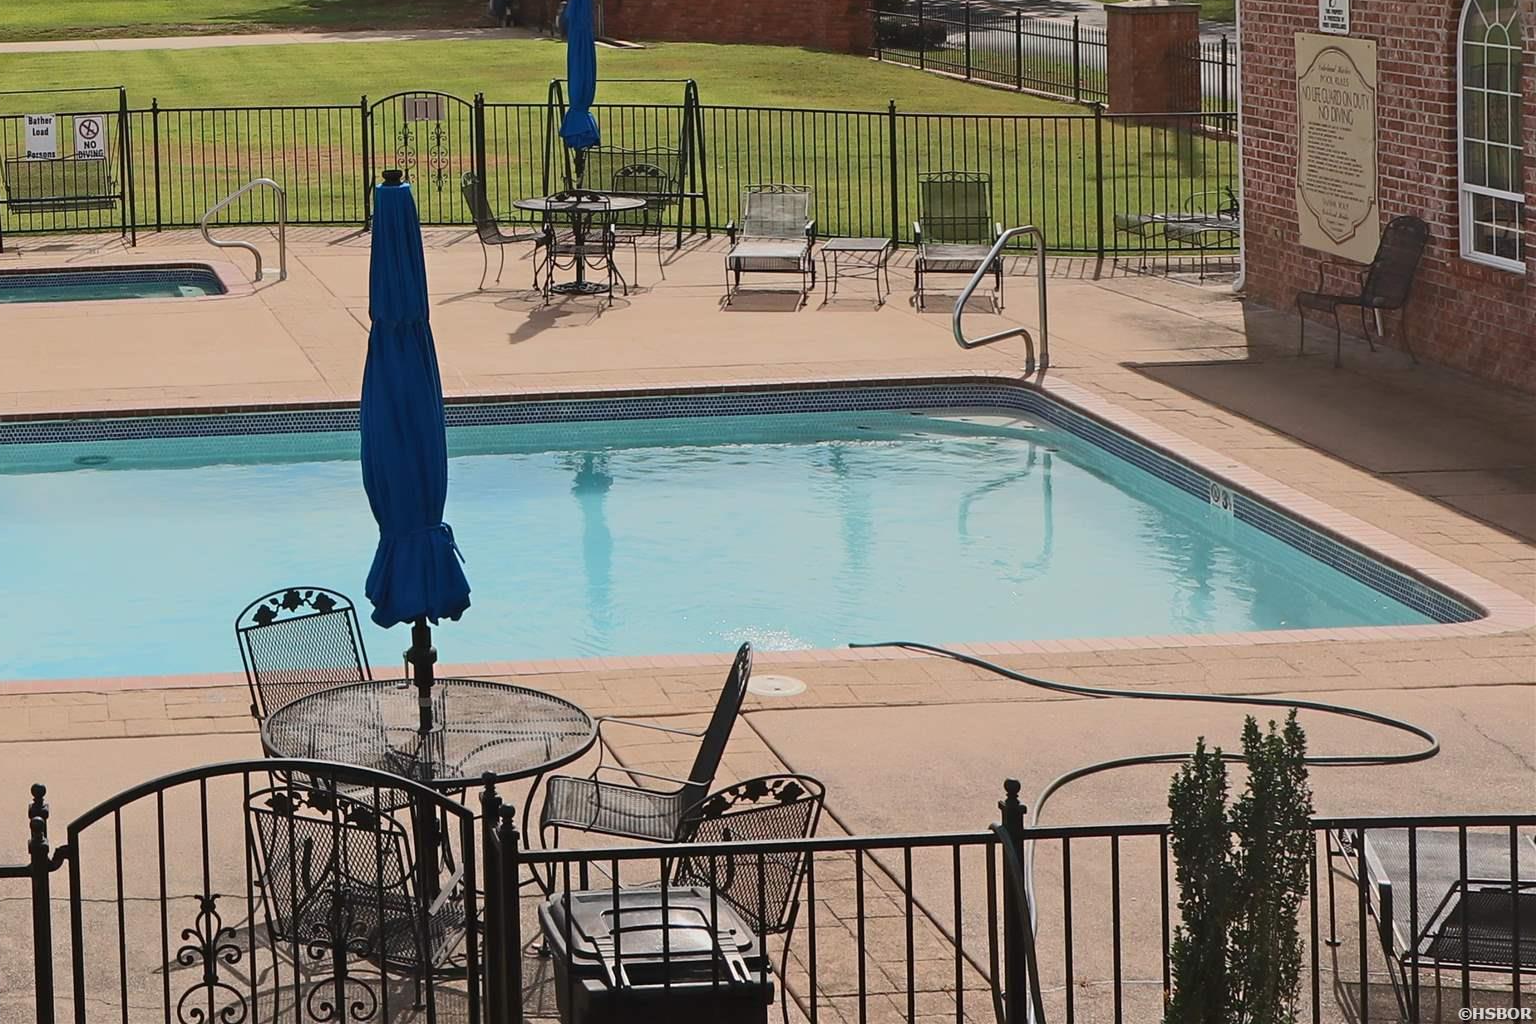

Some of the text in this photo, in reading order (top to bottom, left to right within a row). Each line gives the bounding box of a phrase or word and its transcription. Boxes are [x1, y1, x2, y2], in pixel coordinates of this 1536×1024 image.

[1318, 105, 1354, 125] NO DIVING
[28, 116, 53, 126] Bather
[32, 127, 49, 137] Load
[83, 140, 97, 150] NO
[27, 150, 56, 159] Persons
[78, 149, 104, 159] DIVING
